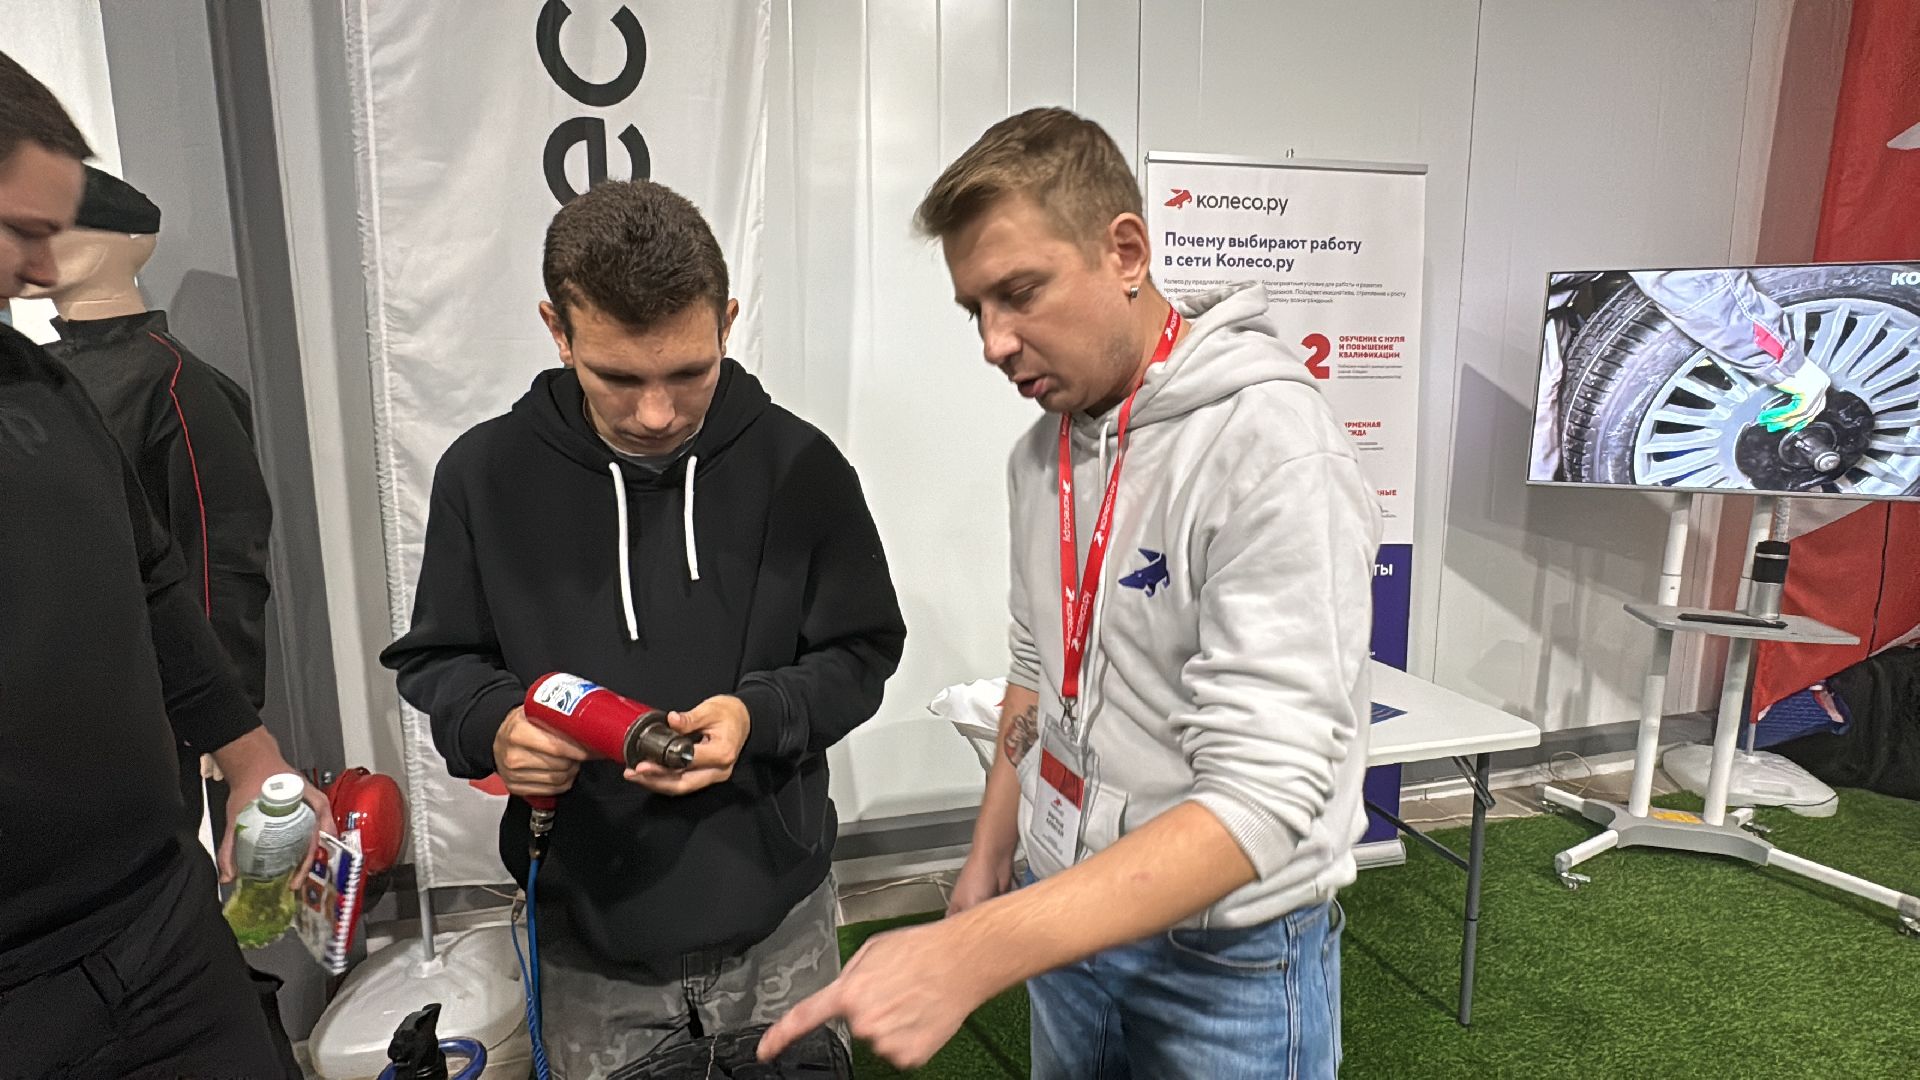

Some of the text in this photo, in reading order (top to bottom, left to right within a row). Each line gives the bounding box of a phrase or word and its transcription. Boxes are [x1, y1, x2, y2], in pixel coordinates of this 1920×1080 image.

[1196, 194, 1289, 216] колесо.ру
[1165, 231, 1362, 254] Почему выбирают работу
[1164, 253, 1295, 272] в сети Колесо.ру
[1300, 333, 1331, 379] 2
[1338, 343, 1345, 351] И
[1338, 351, 1400, 359] КВАЛИФИКАЦИИ
